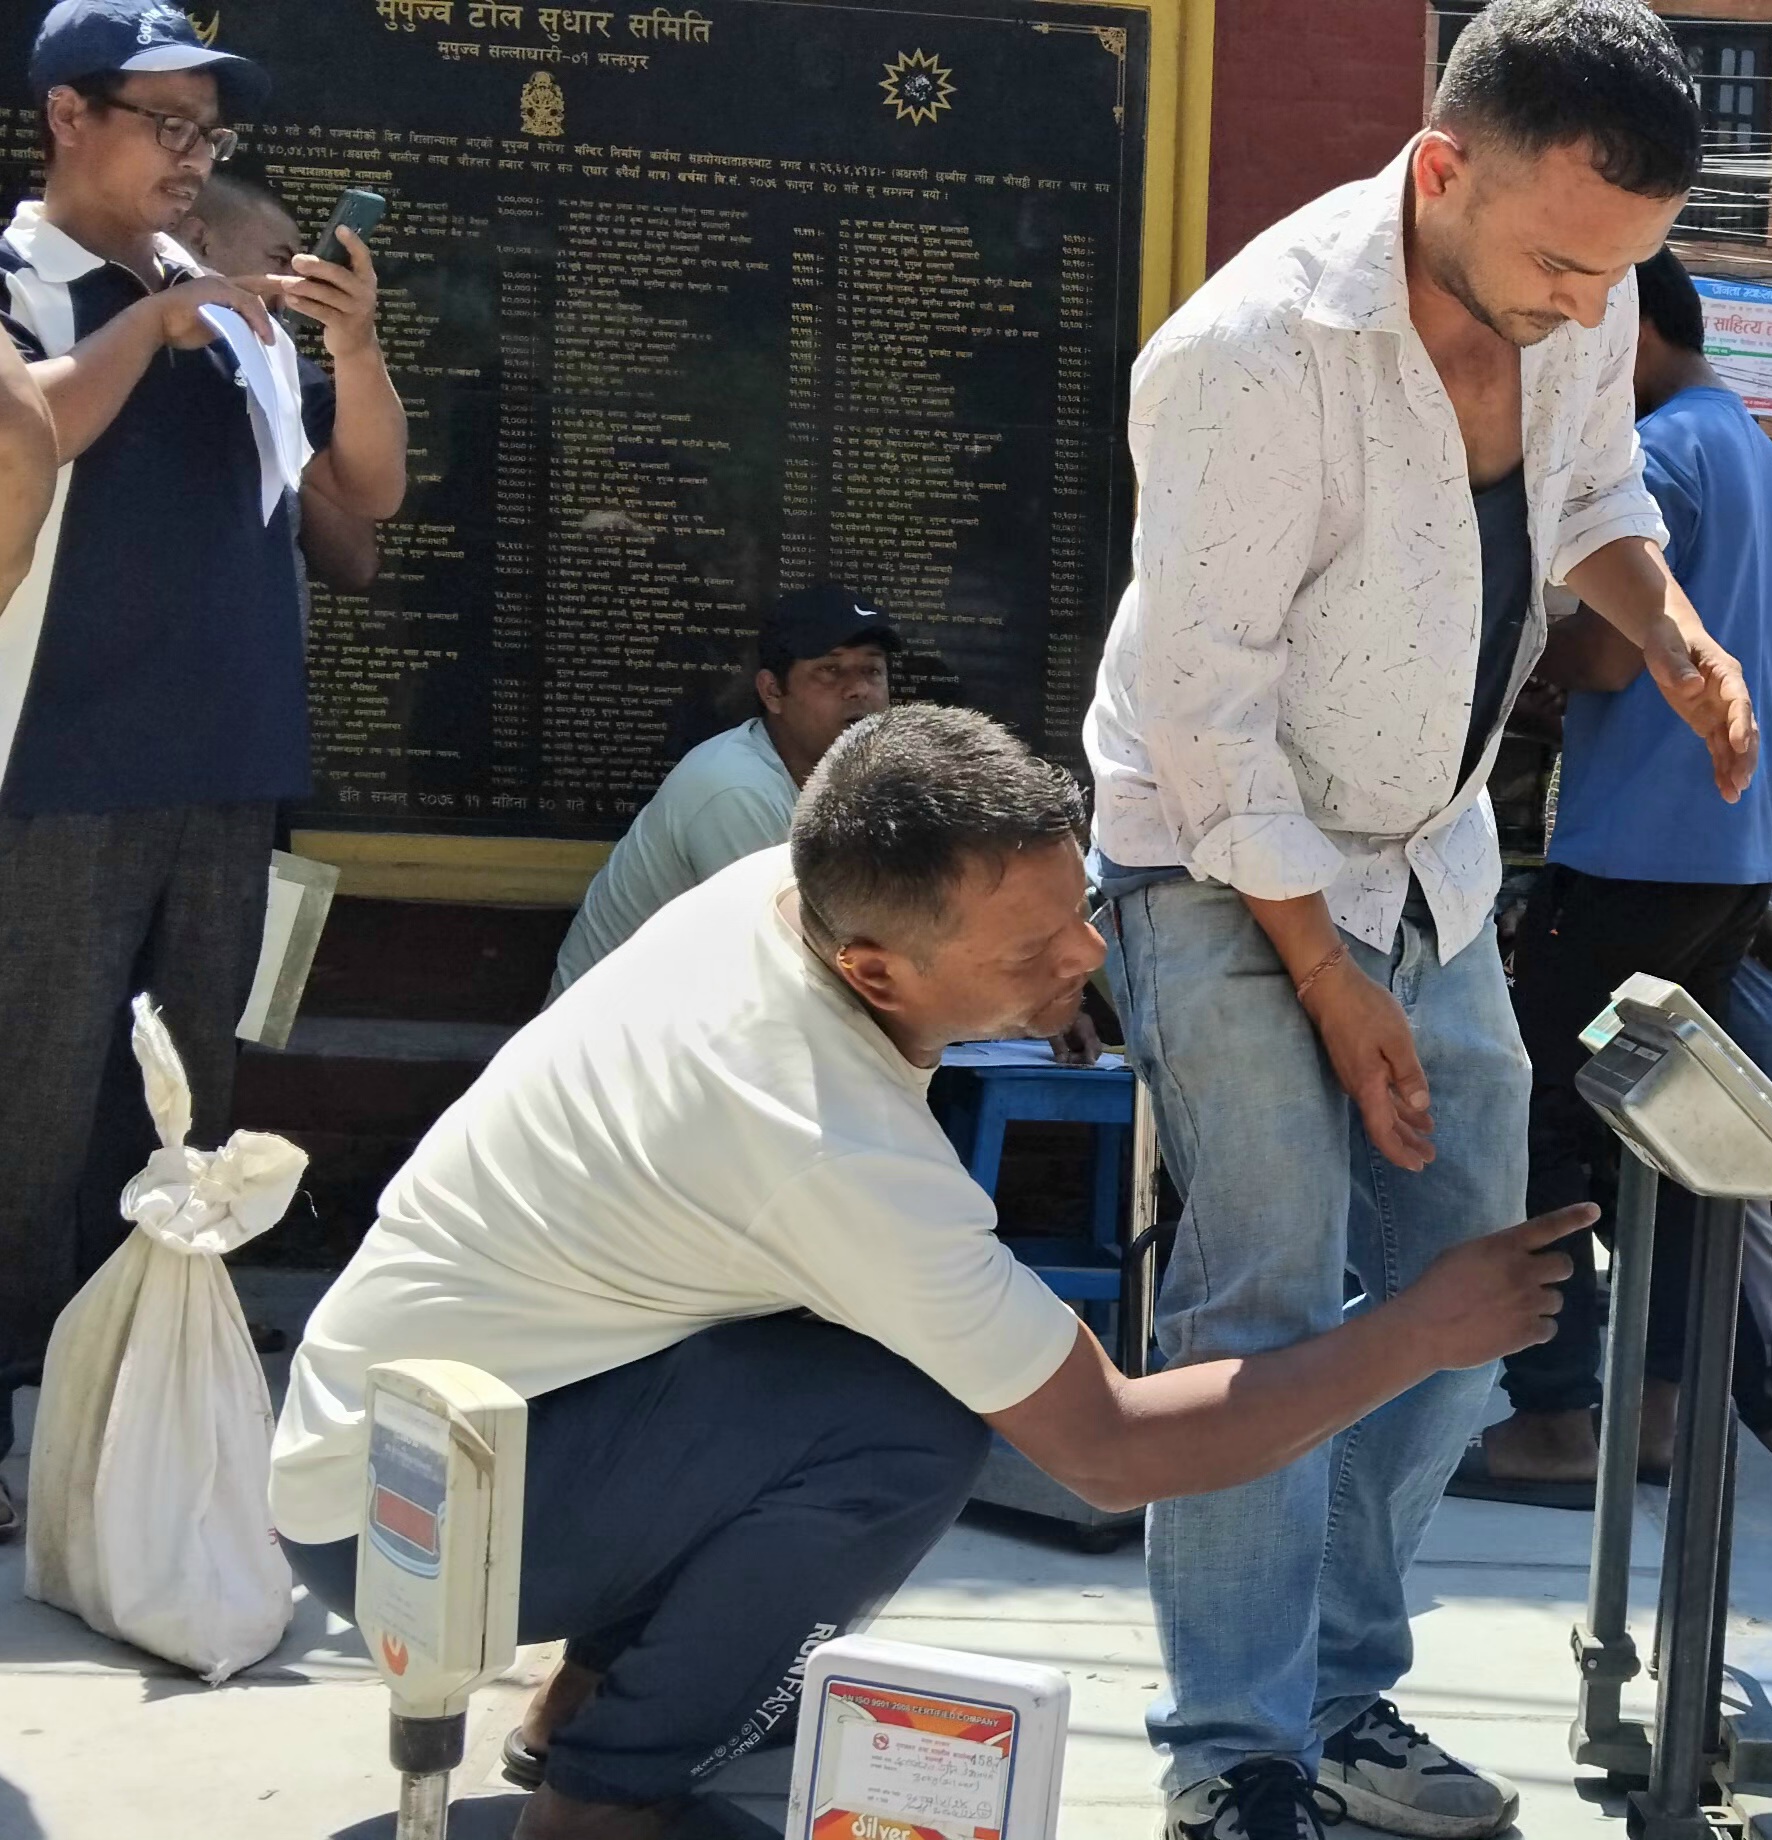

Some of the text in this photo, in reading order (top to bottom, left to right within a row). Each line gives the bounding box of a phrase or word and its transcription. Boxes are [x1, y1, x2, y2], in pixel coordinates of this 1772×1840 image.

[539, 8, 614, 41] सुधार
[629, 8, 713, 44] समिति
[598, 53, 650, 73] भक्तपुर
[1714, 315, 1762, 335] साहित्य
[912, 1706, 955, 1720] CERTIFIED
[957, 1713, 999, 1728] COMPANY
